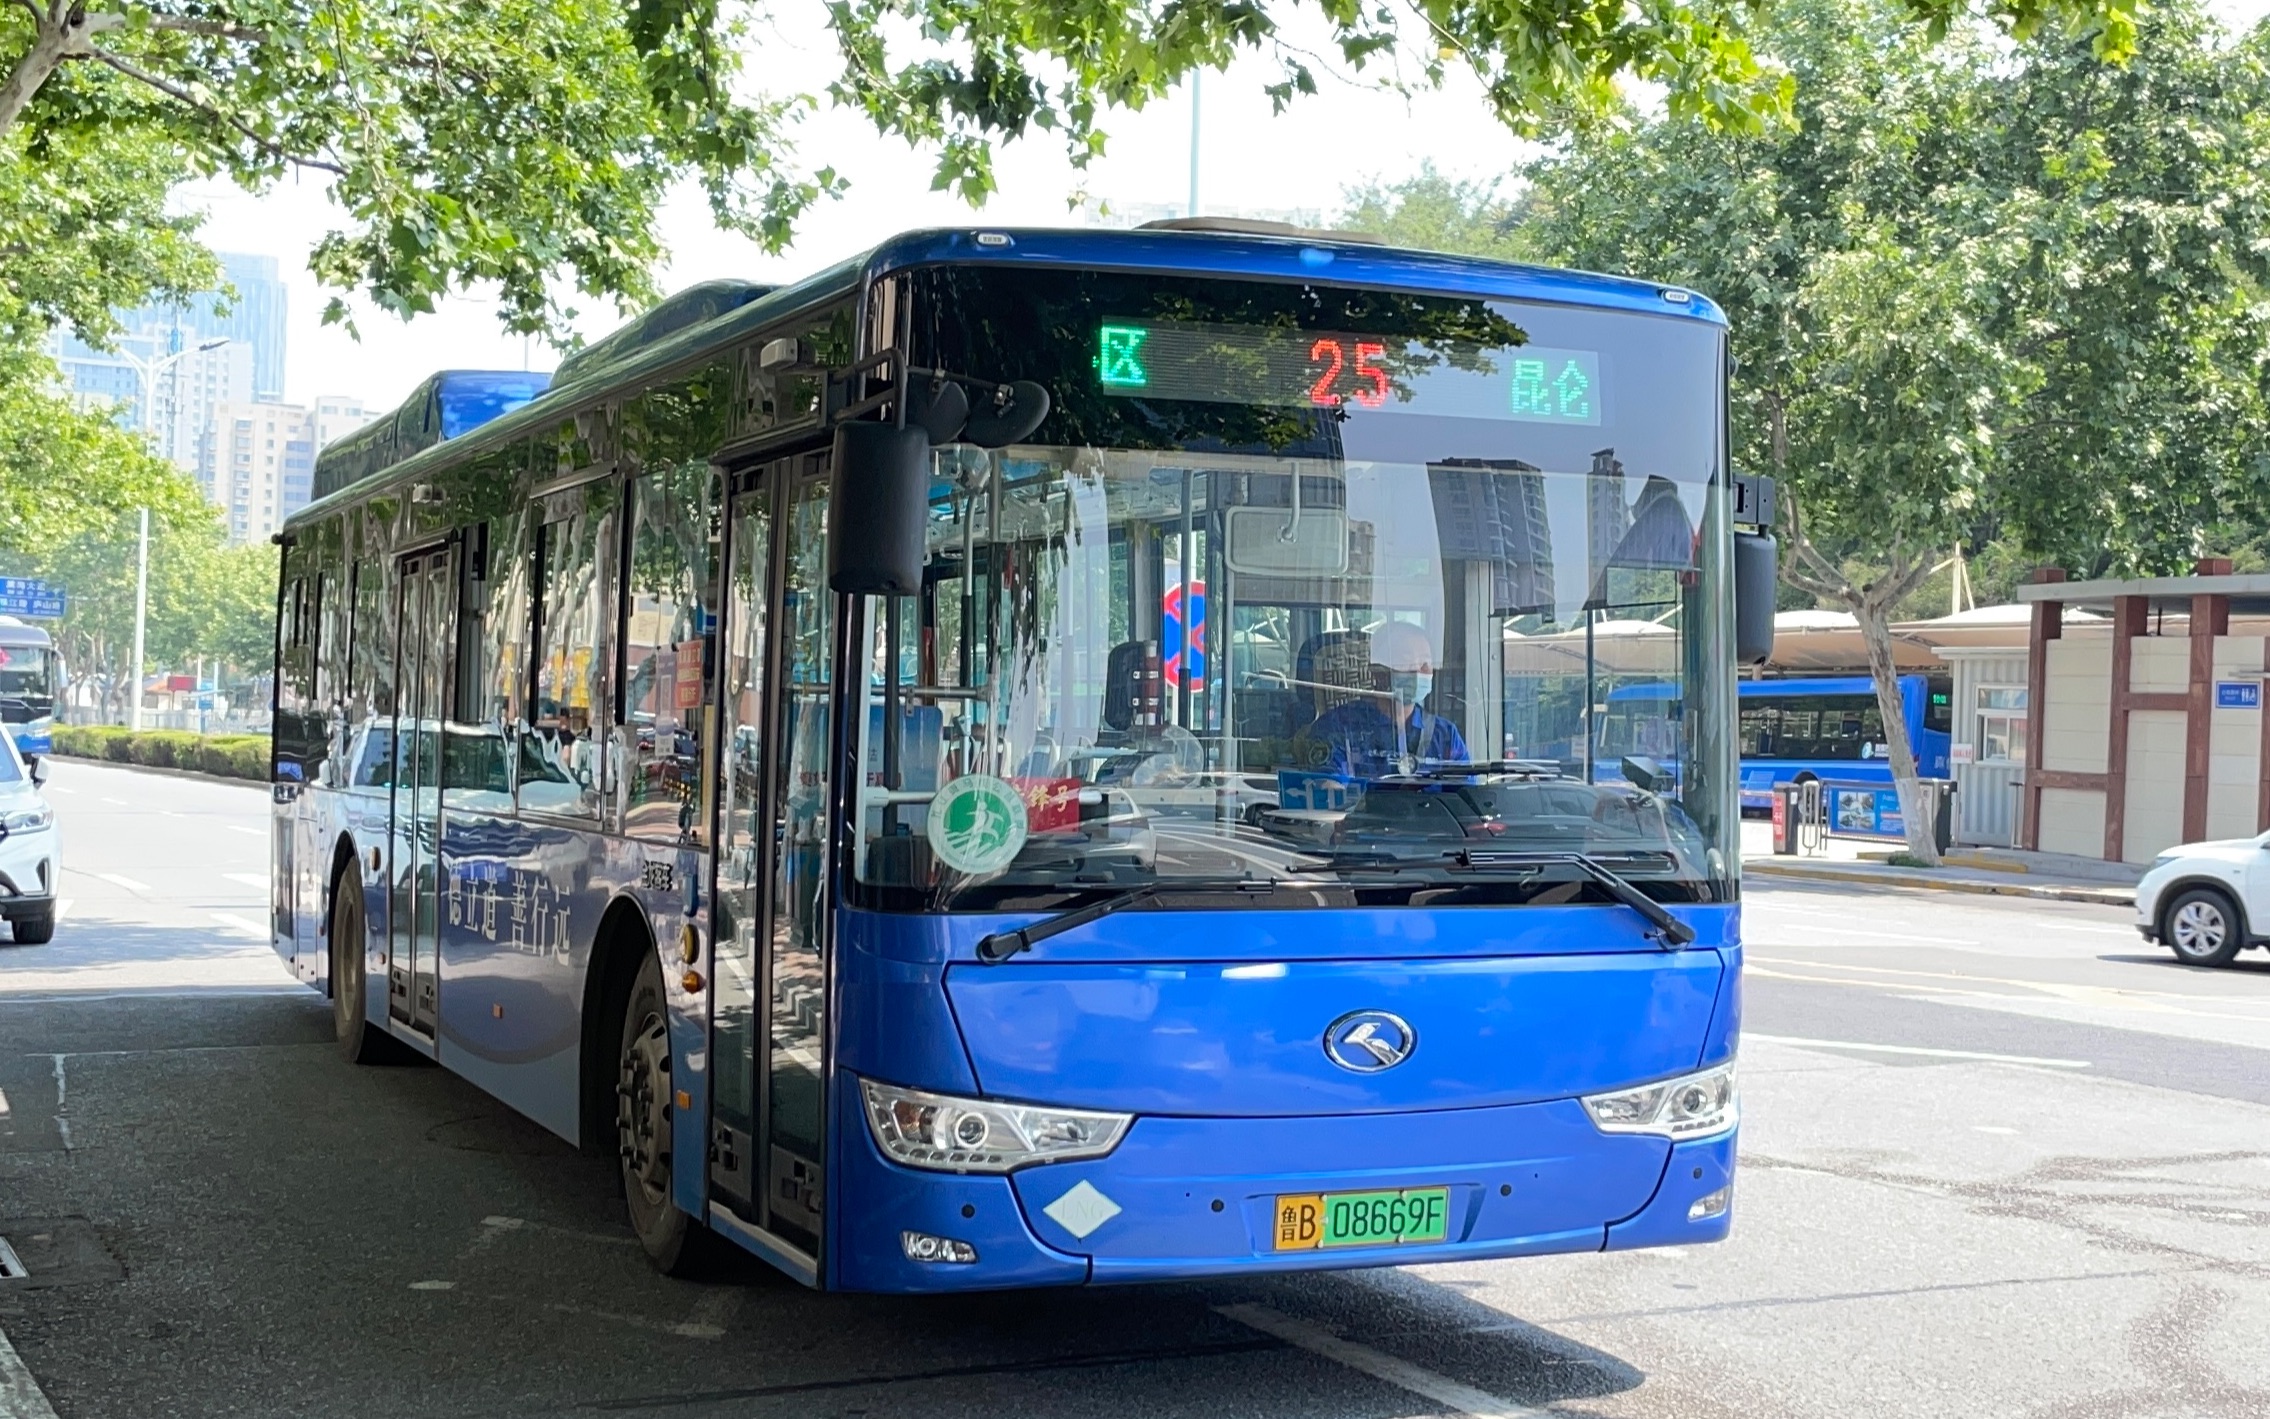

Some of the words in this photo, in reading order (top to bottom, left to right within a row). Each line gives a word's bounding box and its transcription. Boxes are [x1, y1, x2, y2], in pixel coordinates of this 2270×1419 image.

[1100, 325, 1147, 385] 区
[1310, 338, 1389, 408] 25
[1510, 359, 1589, 418] 昆仑
[510, 870, 571, 966] 善行远
[1281, 1204, 1316, 1241] 鲁B
[1333, 1196, 1444, 1238] 08669F
